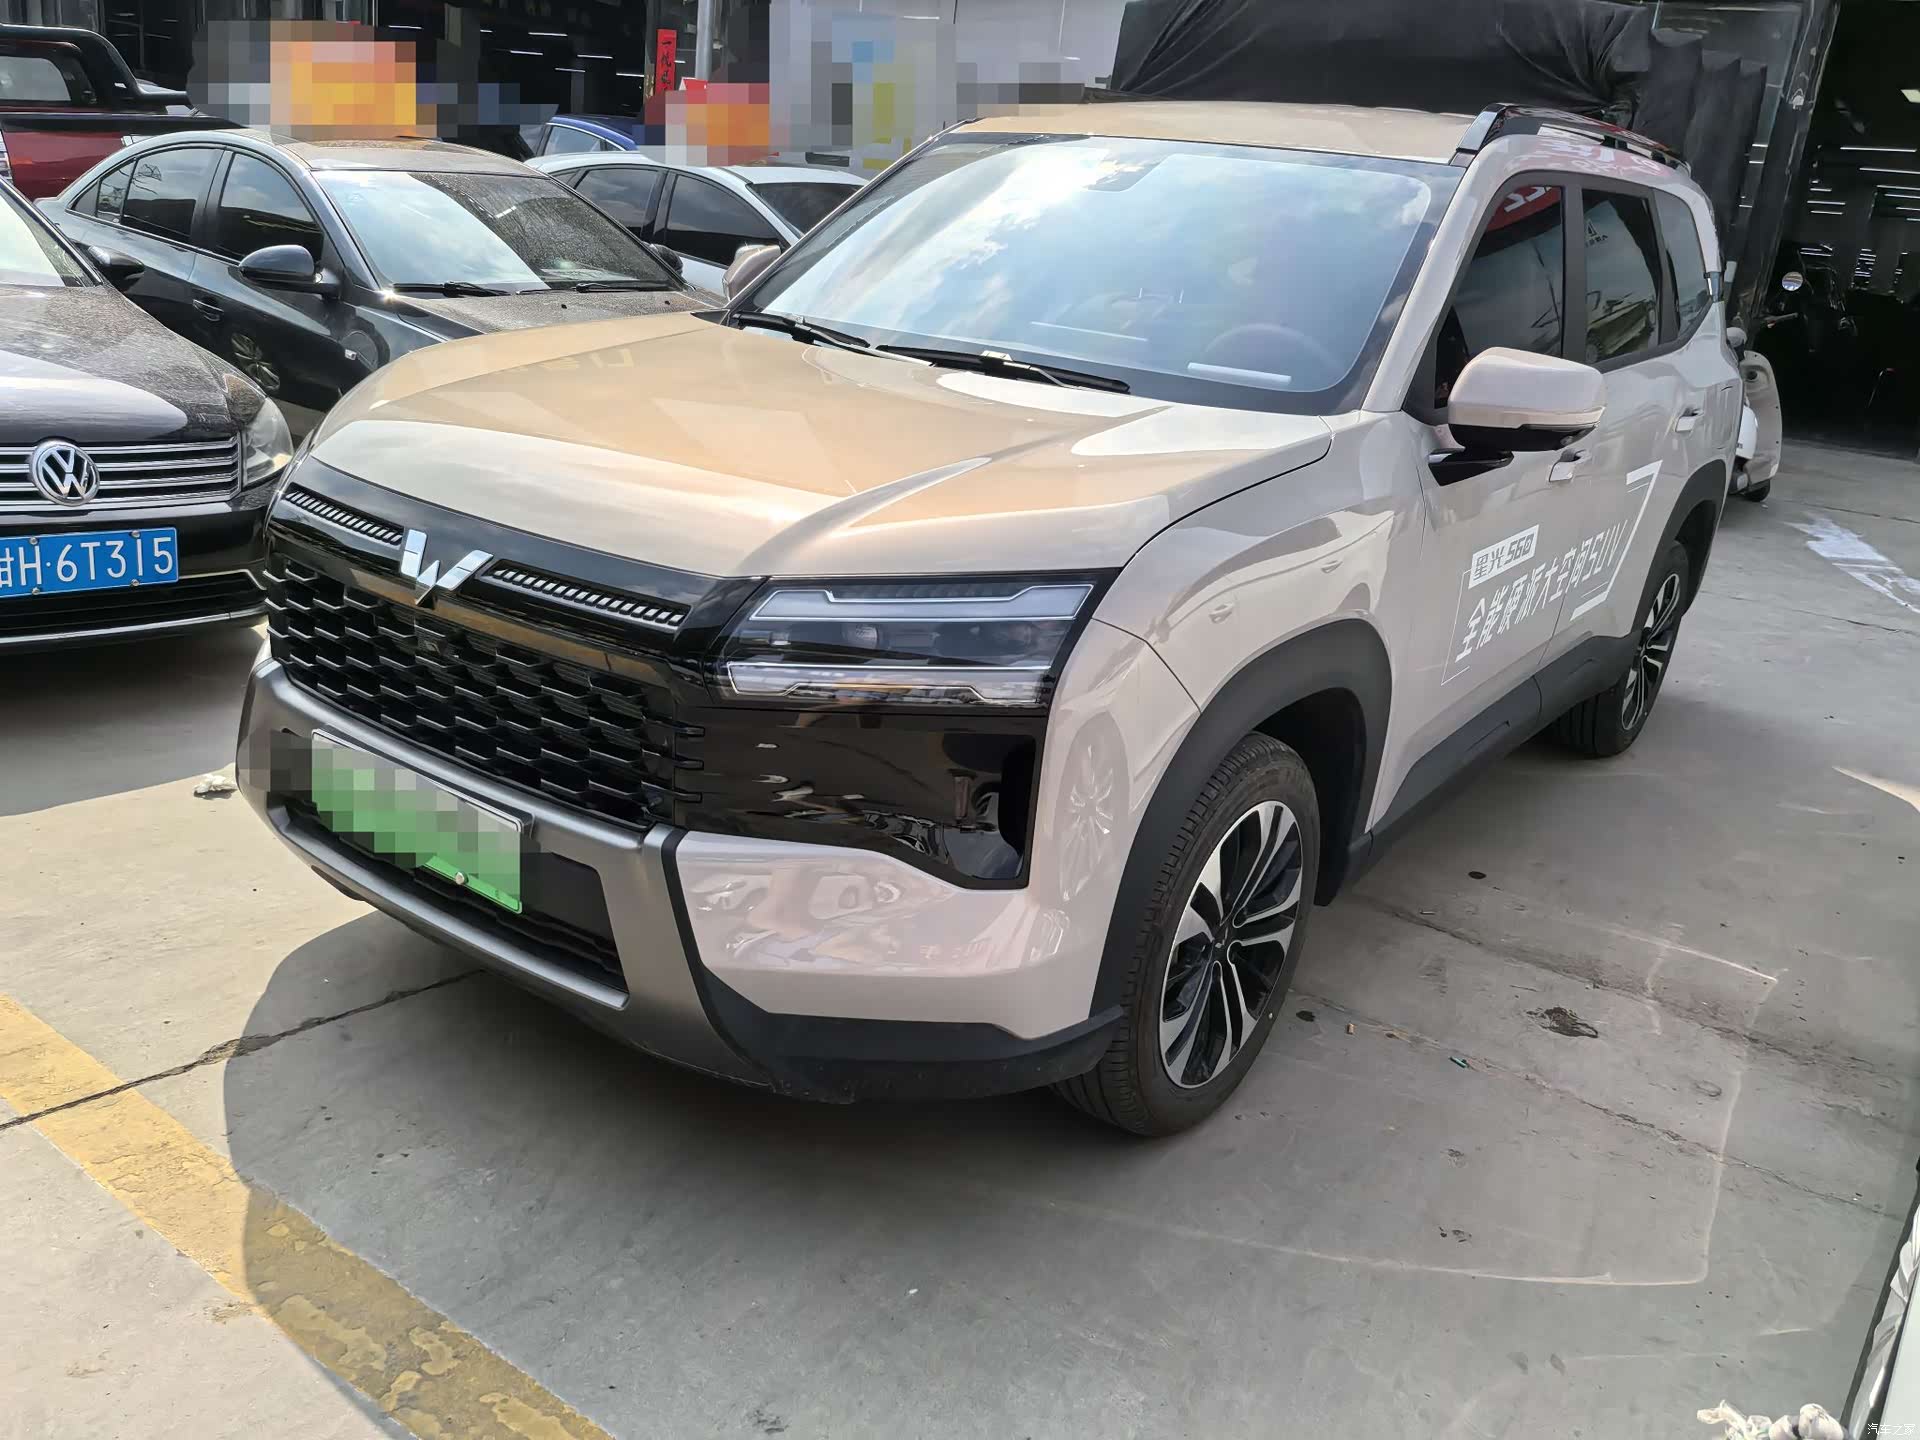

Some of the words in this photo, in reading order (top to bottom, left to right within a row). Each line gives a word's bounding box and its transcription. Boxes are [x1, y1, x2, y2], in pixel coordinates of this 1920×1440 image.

[1454, 520, 1627, 662] 全能硬派大空间SUV
[1474, 534, 1534, 579] 星光560
